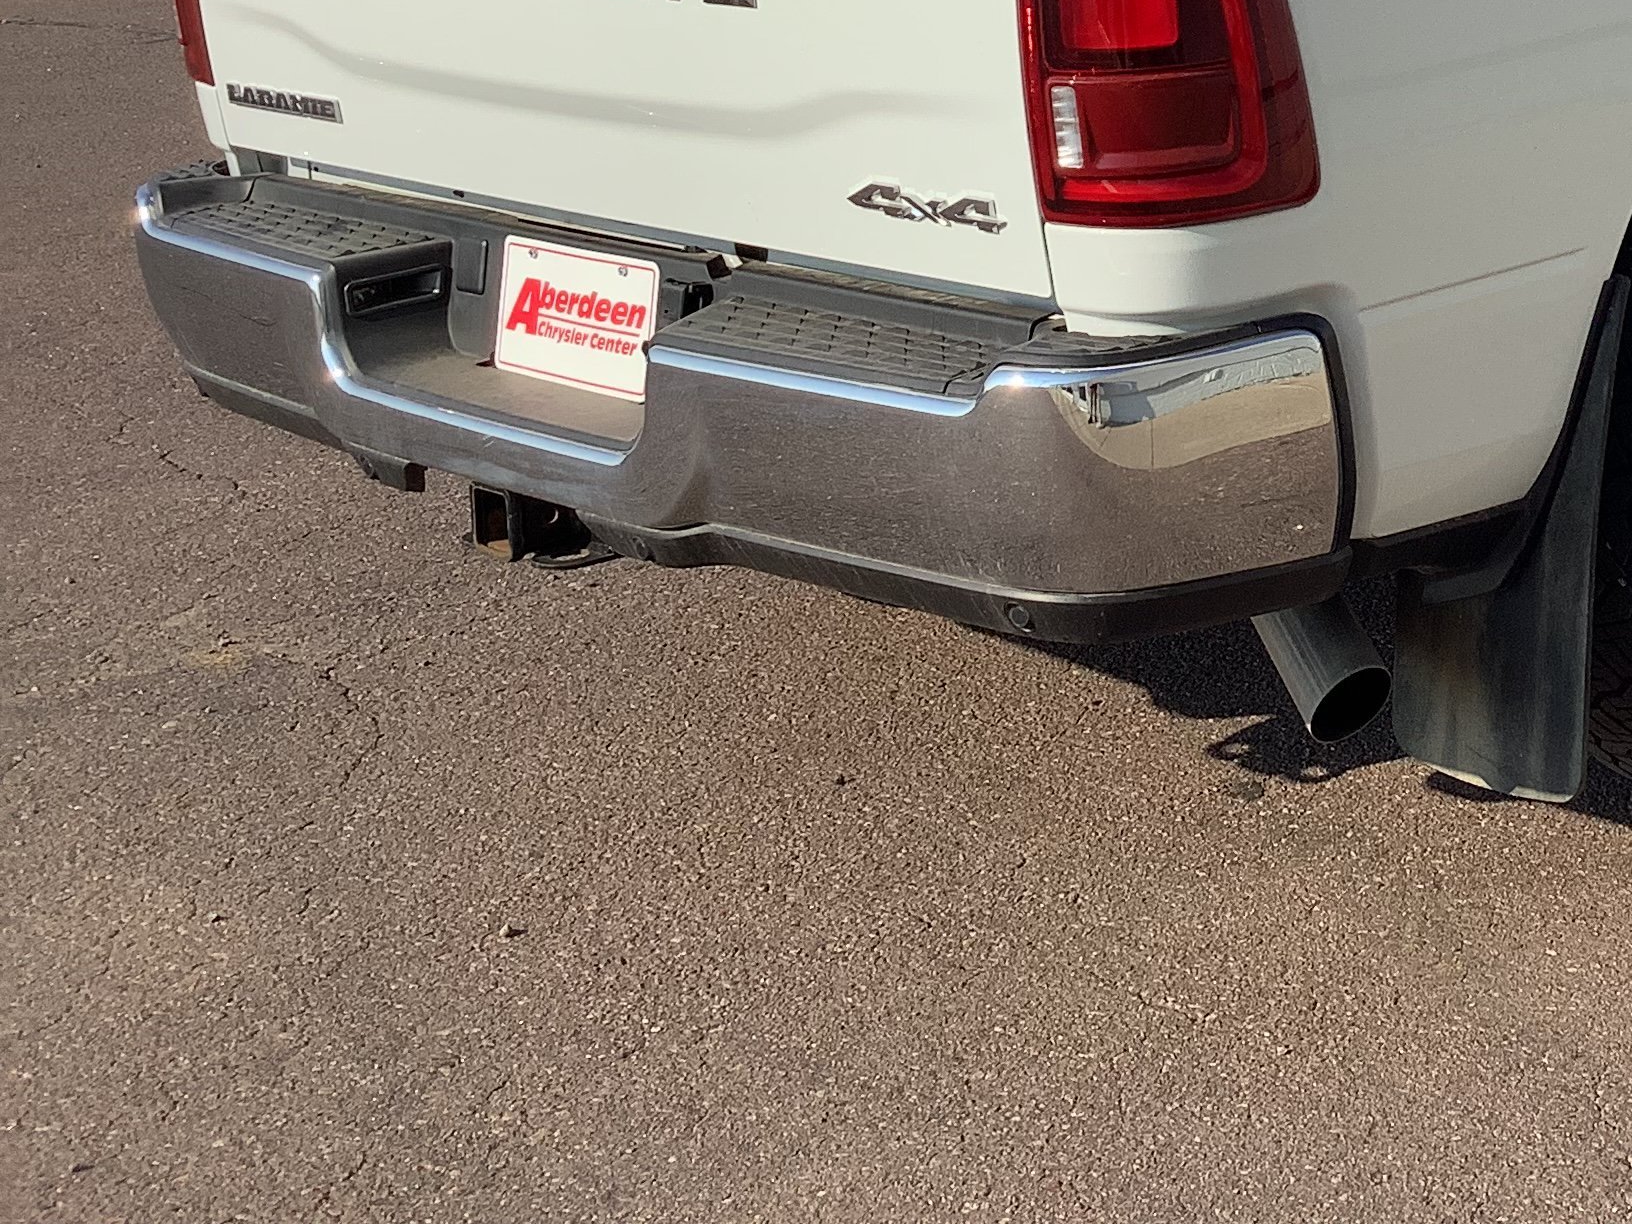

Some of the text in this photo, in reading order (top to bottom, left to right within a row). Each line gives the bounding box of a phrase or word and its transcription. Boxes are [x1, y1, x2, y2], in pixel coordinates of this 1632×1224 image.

[226, 82, 343, 124] LARAMIE
[505, 277, 647, 335] Aberdeen
[537, 320, 637, 356] Chrysler Center
